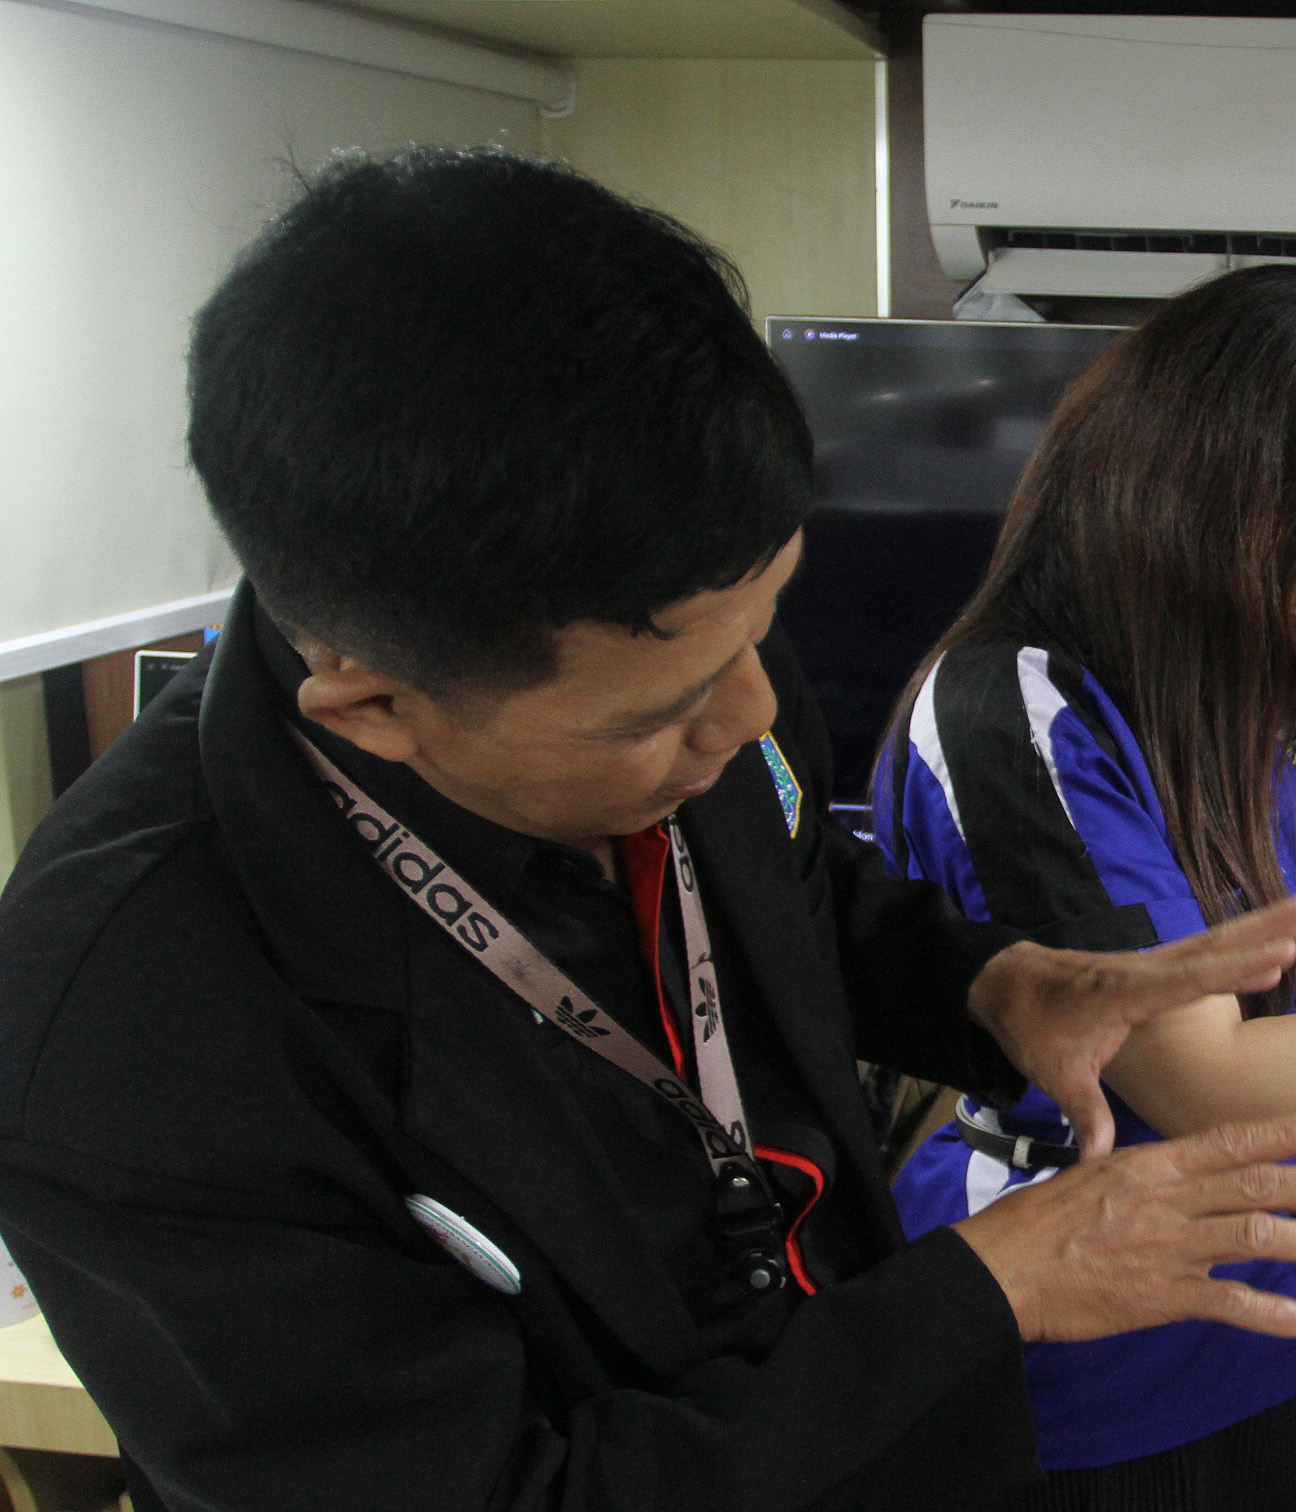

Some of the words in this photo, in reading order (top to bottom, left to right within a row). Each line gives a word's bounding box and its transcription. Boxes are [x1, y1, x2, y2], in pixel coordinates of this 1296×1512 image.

[819, 332, 838, 340] Media
[838, 332, 858, 341] Player
[654, 1078, 739, 1160] adid
